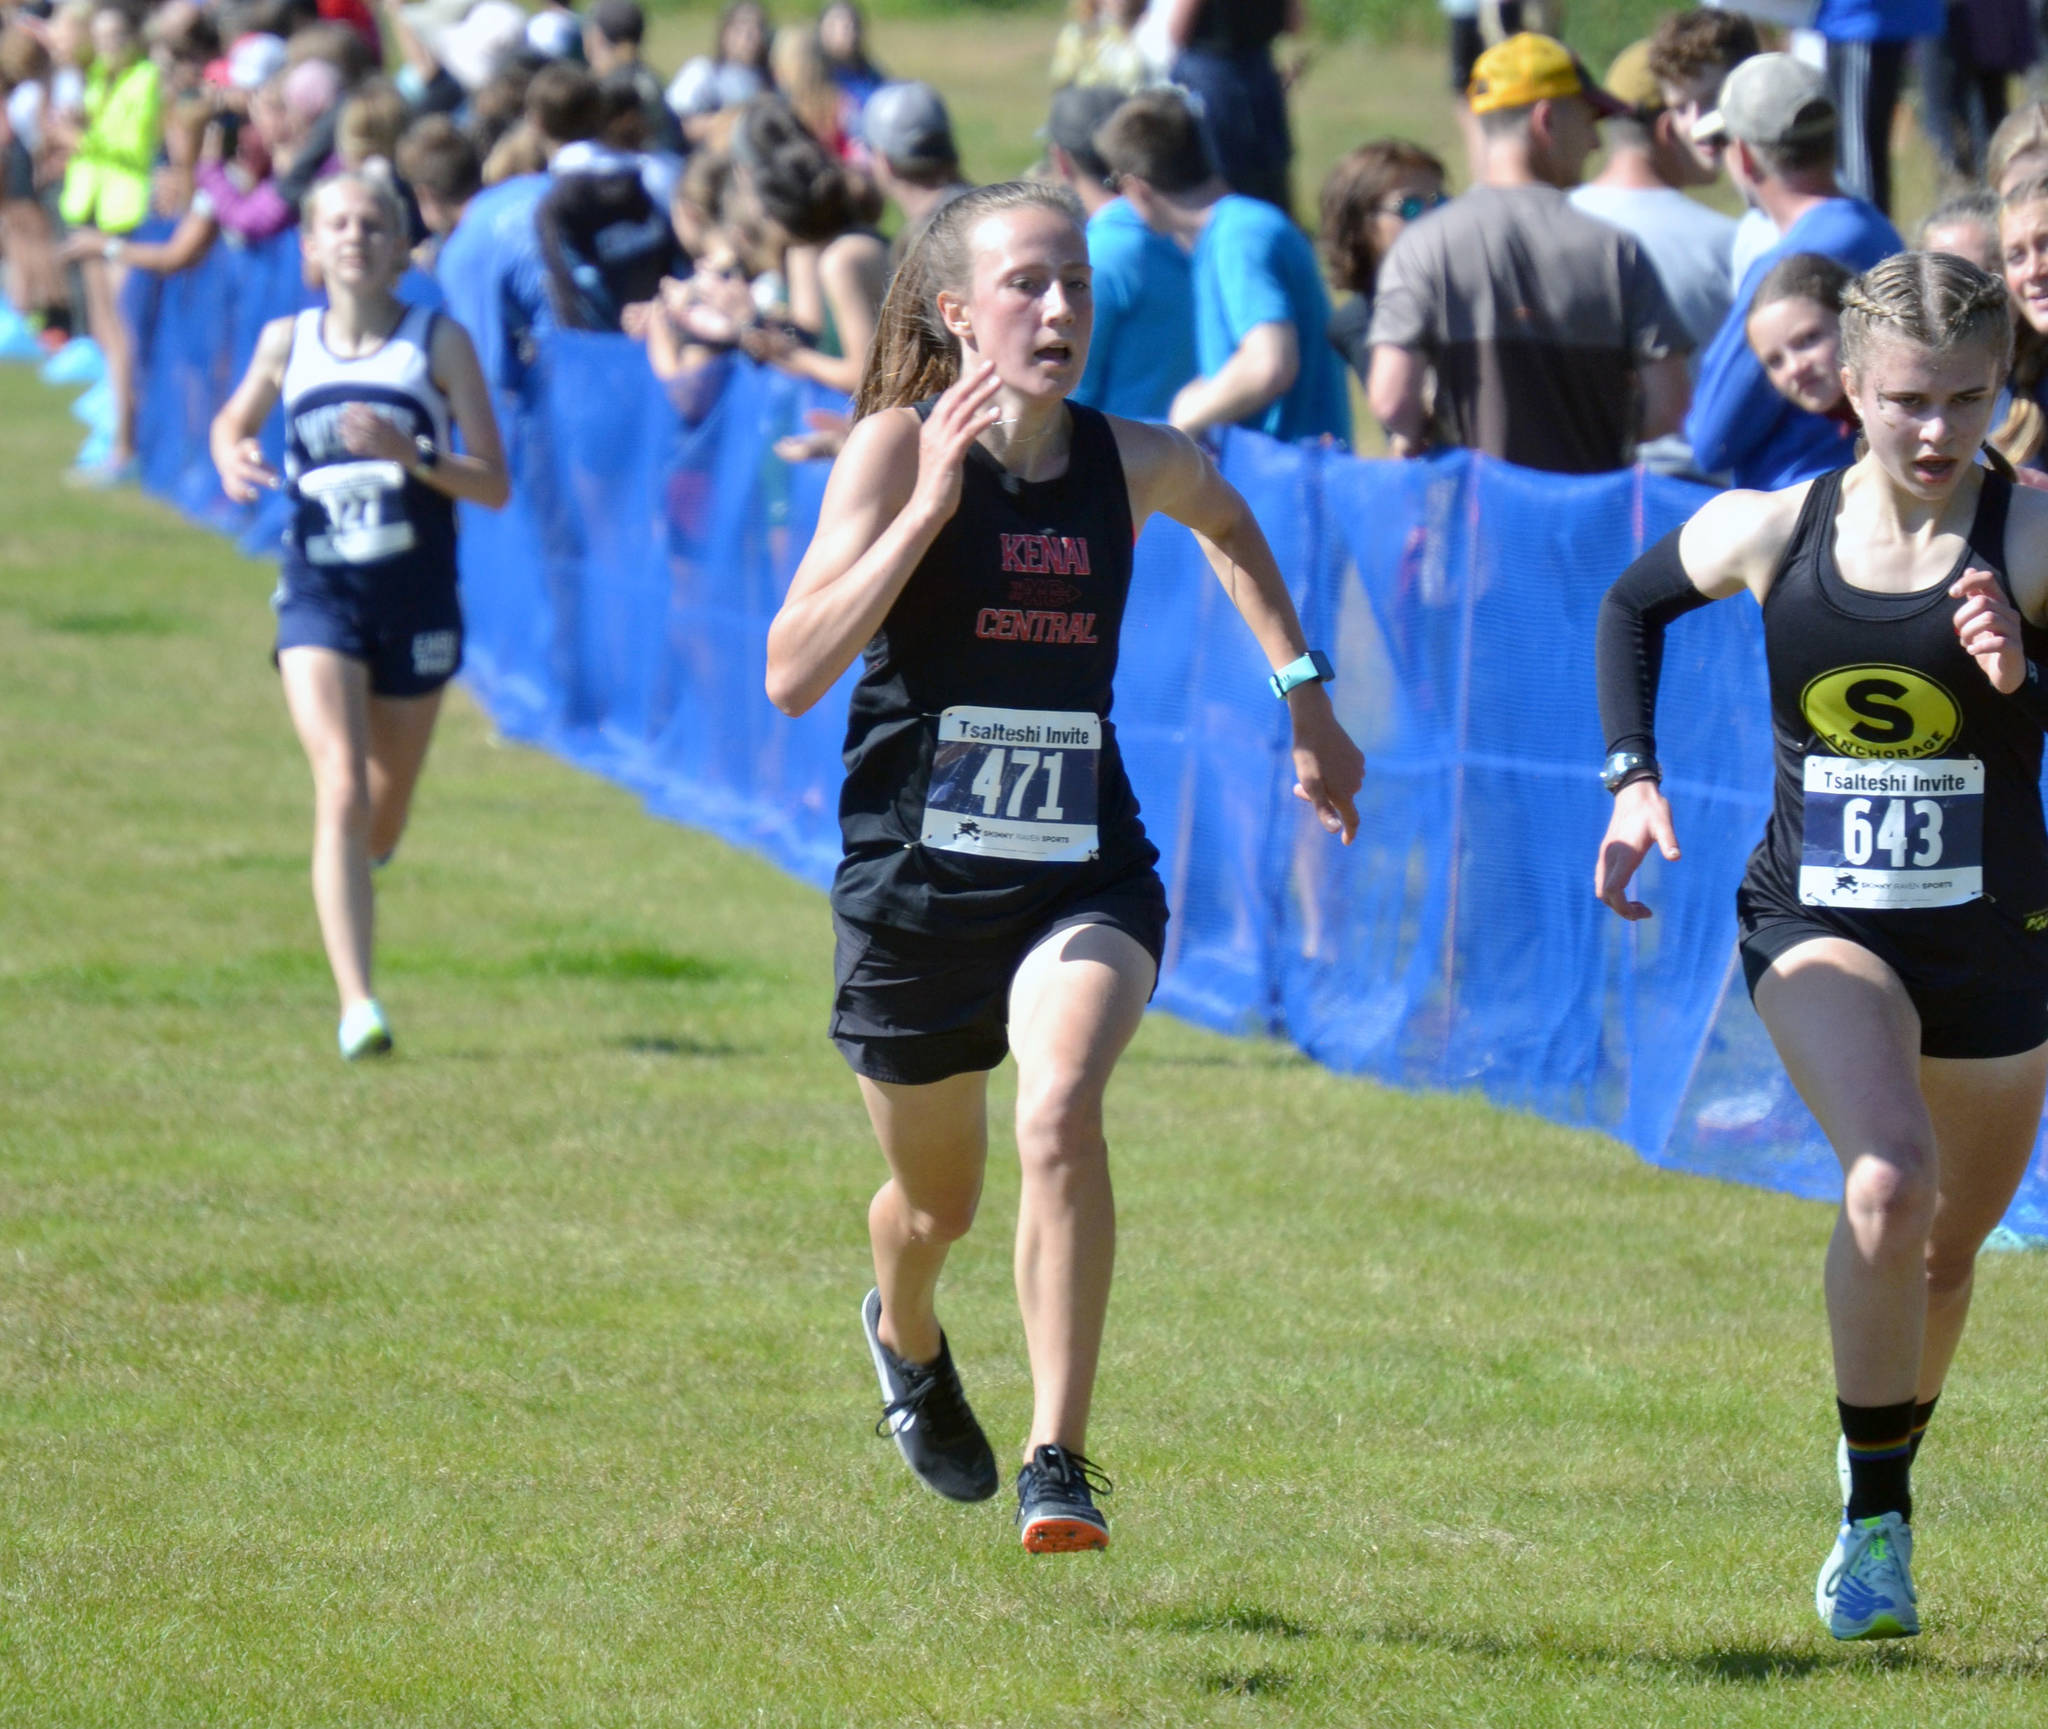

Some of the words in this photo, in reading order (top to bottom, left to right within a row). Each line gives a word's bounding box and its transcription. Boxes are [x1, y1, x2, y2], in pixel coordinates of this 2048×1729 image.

[1000, 533, 1091, 576] KENAI
[976, 607, 1098, 644] CENTRAL
[1844, 678, 1915, 744] S
[959, 720, 1041, 743] Tsalteshi
[1046, 726, 1090, 745] Invite
[1827, 730, 1946, 759] ANCHORAGE
[971, 748, 1064, 820] 471
[1824, 771, 1908, 792] Tsalteshi
[1914, 774, 1966, 792] Invite
[1843, 798, 1944, 868] 643
